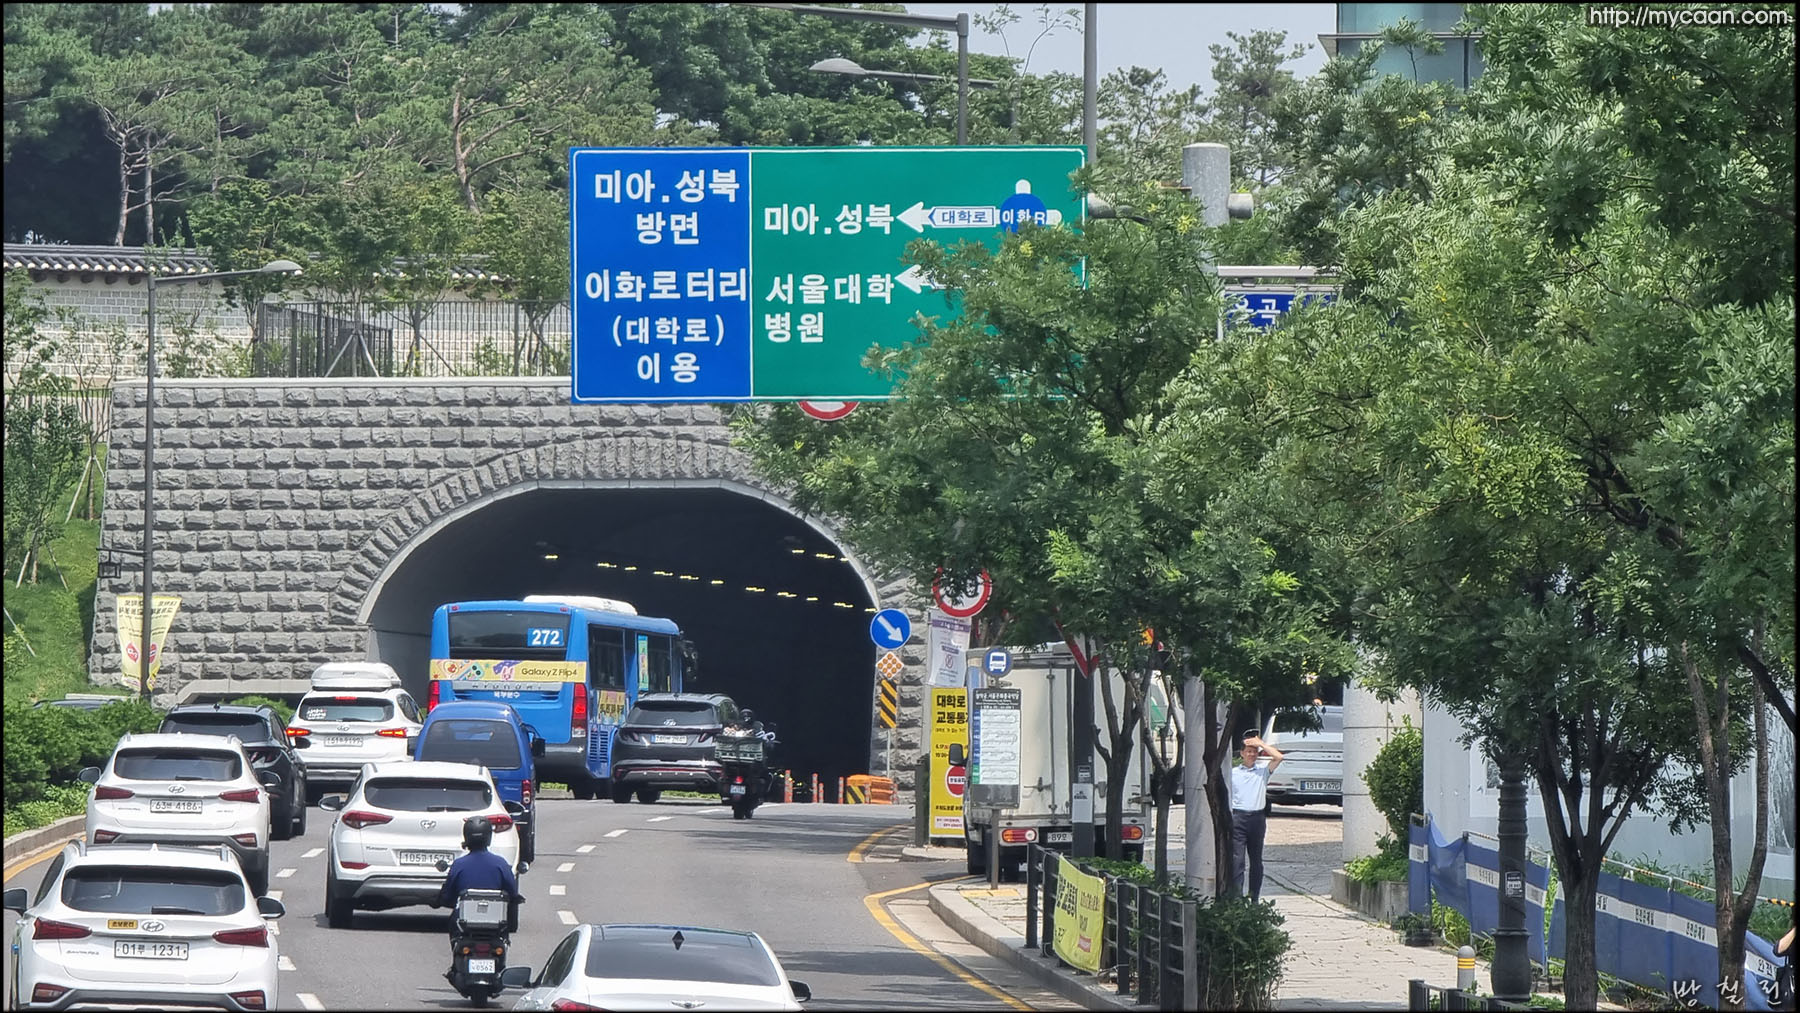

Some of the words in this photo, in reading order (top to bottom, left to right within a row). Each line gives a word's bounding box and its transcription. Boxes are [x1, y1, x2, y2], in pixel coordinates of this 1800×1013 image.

[595, 169, 740, 203] 미아.성북
[636, 211, 699, 245] 방면
[764, 203, 894, 235] 미아.성북
[941, 210, 988, 224] 대학로
[585, 268, 747, 302] 이화로터리
[765, 273, 895, 305] 서울대학
[612, 314, 725, 347] (대학로)
[765, 312, 824, 343] 병원
[637, 352, 700, 384] 이용
[532, 629, 560, 645] 272
[521, 668, 552, 677] Galaxy
[552, 668, 558, 676] Z
[558, 668, 578, 678] Flip4
[936, 695, 966, 709] 대학로
[175, 802, 198, 811] 4186
[152, 944, 181, 956] 1231
